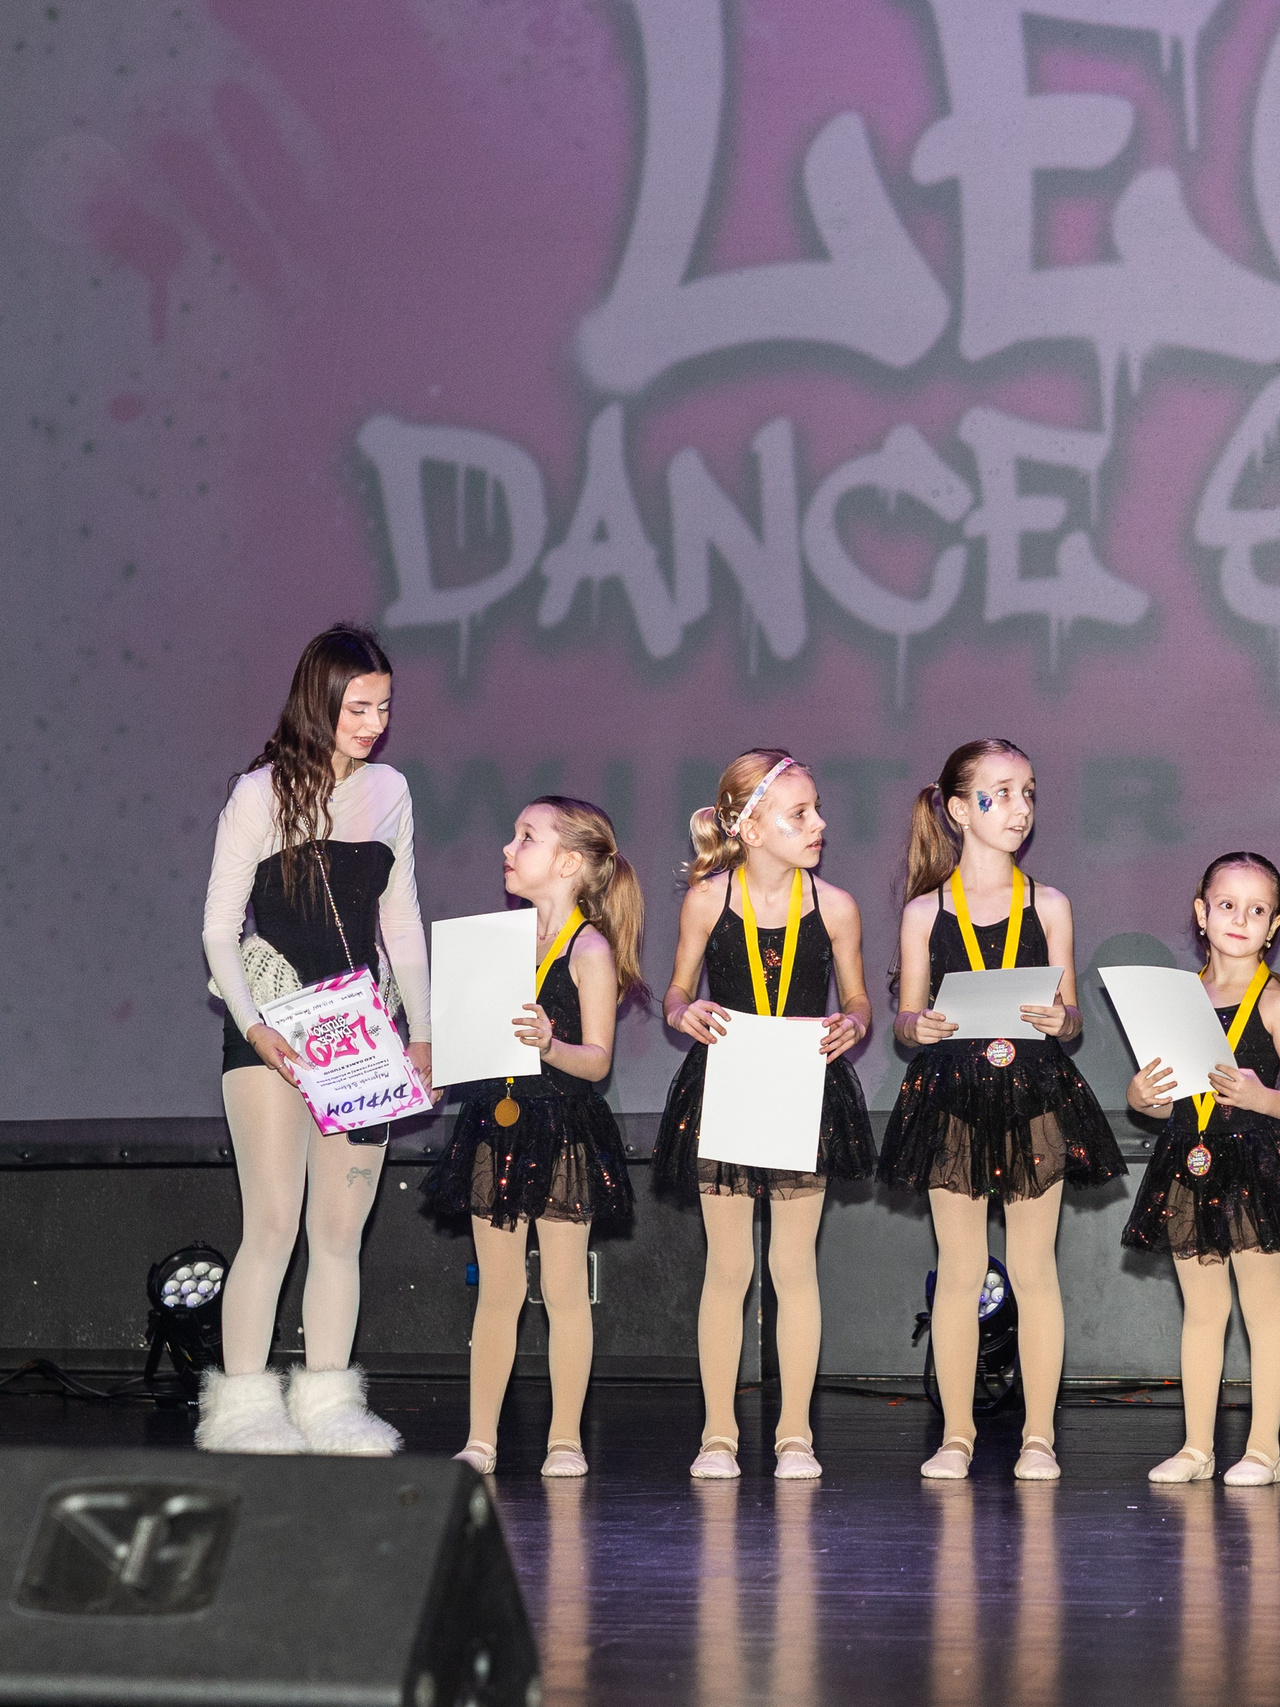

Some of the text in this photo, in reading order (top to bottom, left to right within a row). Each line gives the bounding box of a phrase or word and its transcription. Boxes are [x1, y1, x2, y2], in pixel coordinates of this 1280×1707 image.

[357, 405, 1150, 665] DANCE
[400, 754, 1190, 847] WITR
[317, 1025, 354, 1046] DANCE
[326, 1082, 409, 1117] DYPLOM
